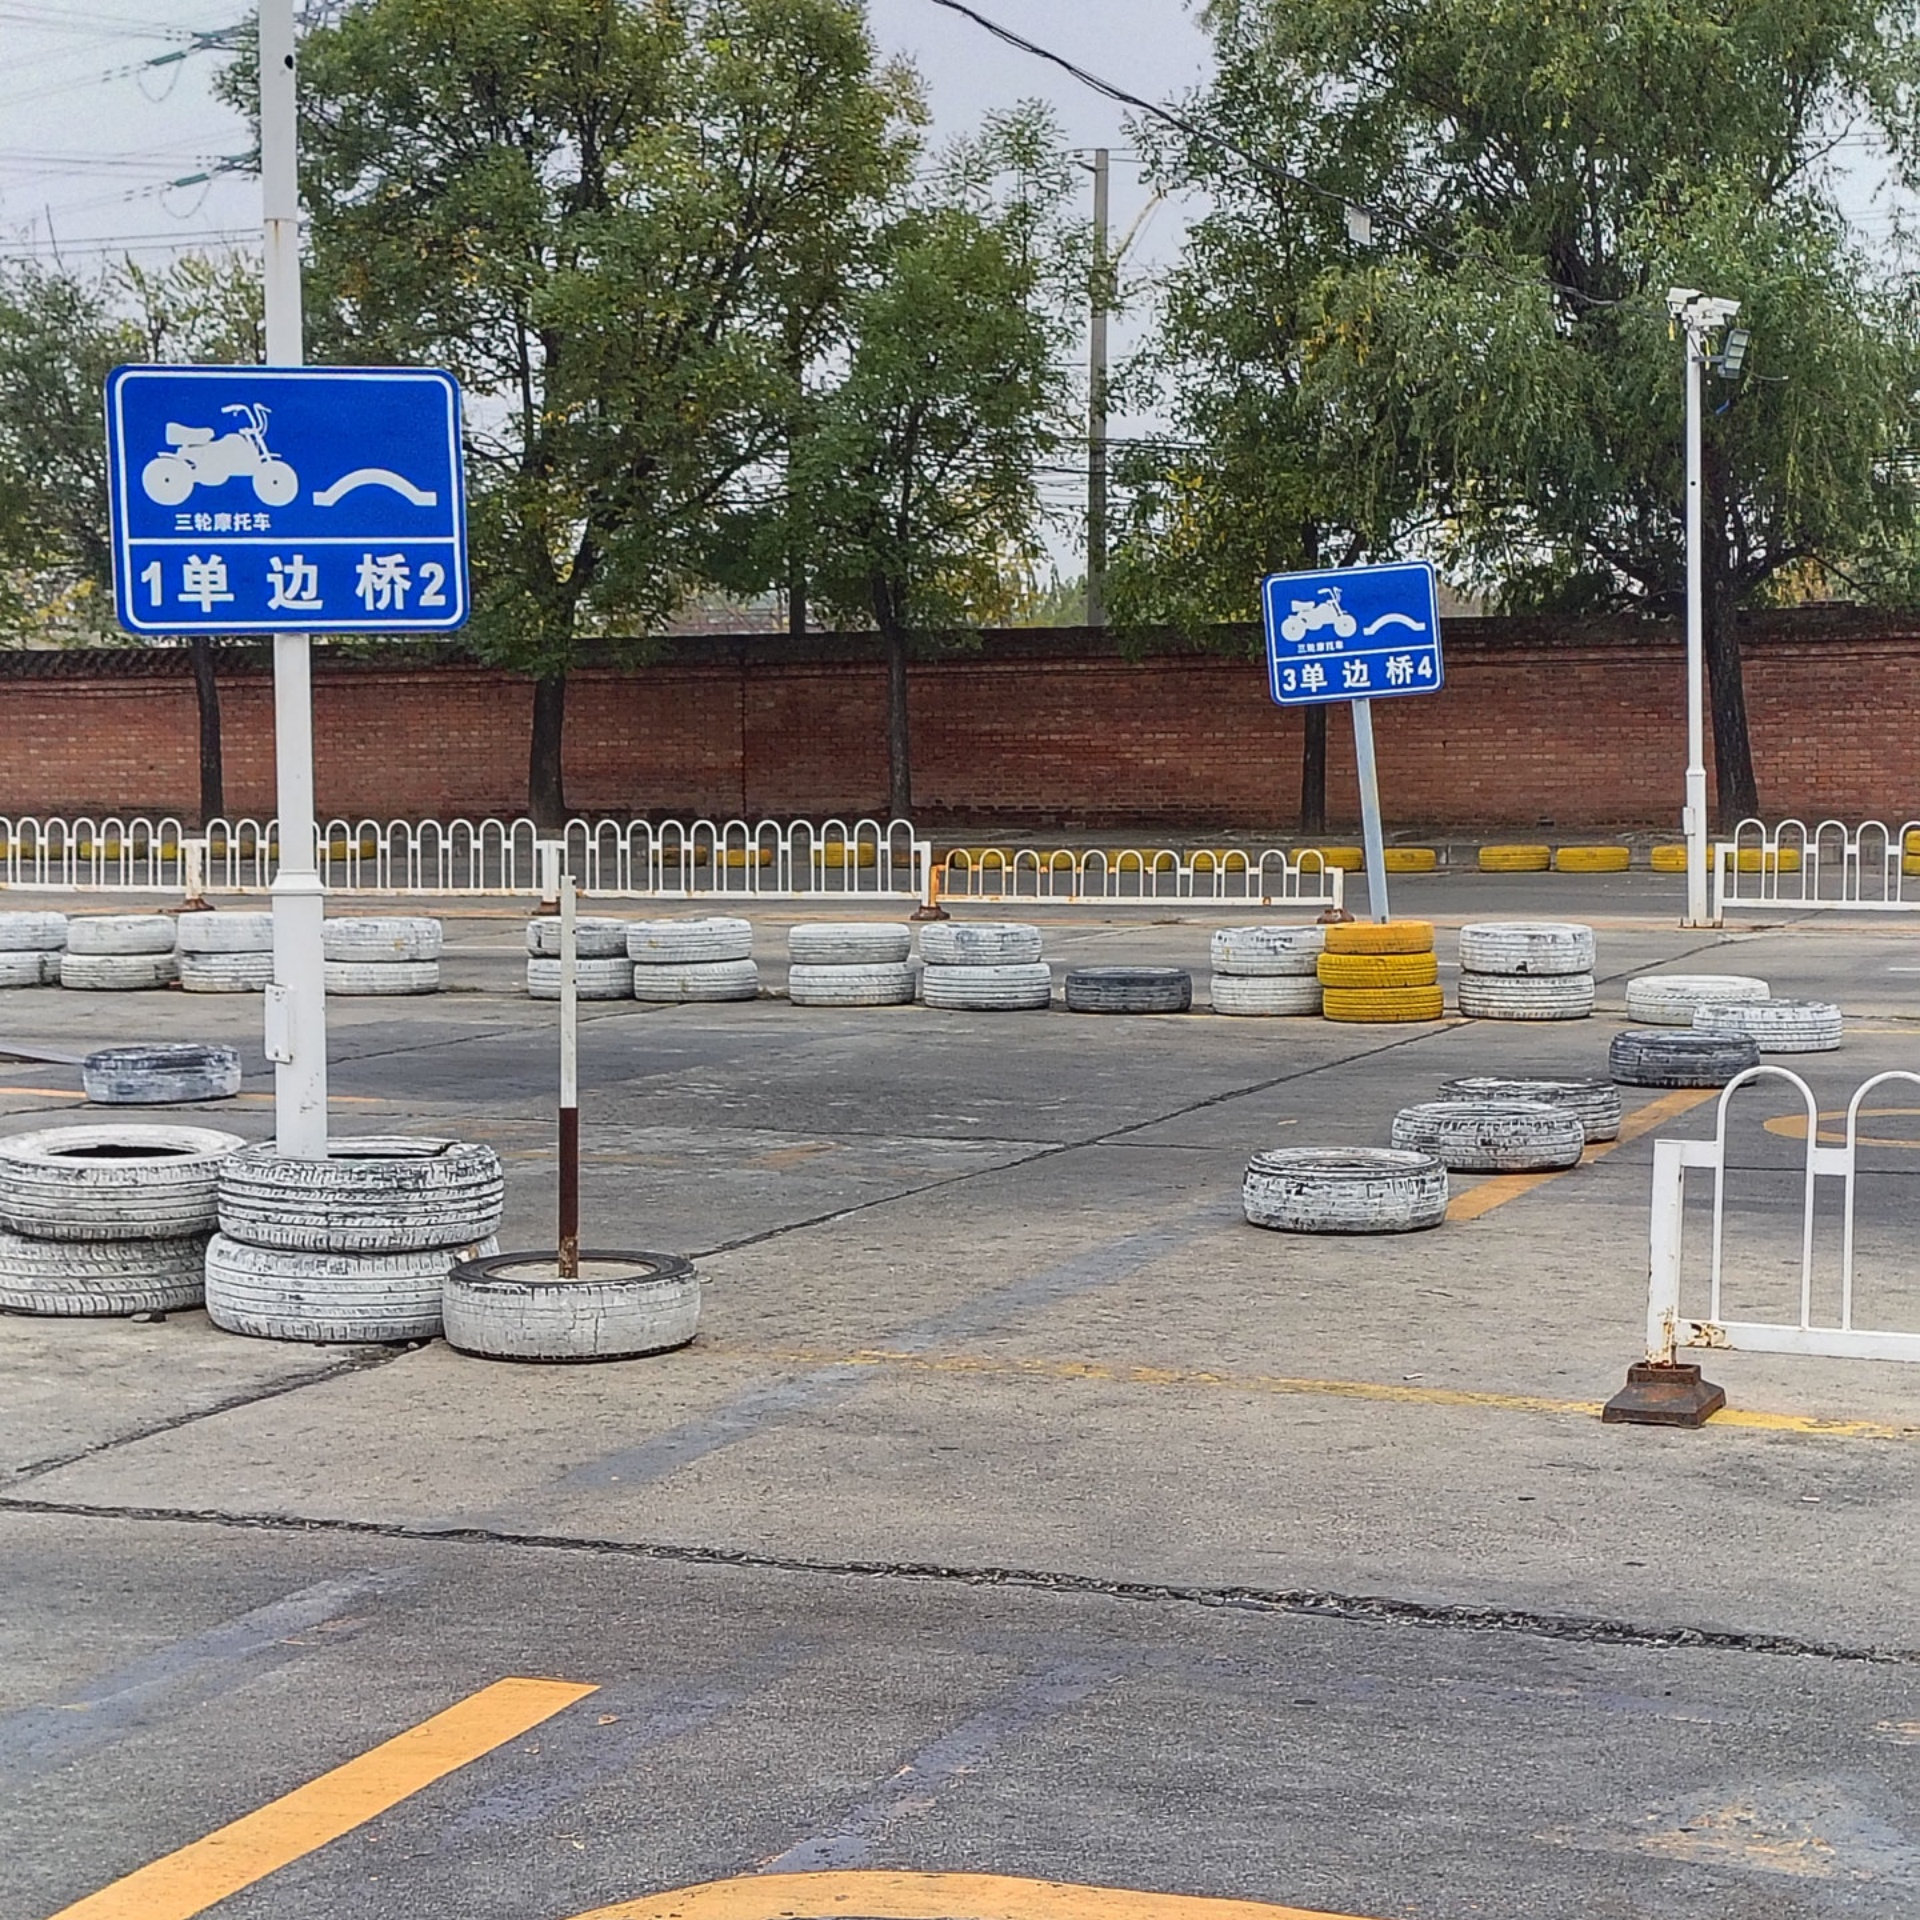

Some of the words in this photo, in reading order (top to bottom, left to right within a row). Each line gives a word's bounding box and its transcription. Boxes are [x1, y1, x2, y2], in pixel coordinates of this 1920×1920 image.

[174, 512, 272, 532] 三轮摩托车
